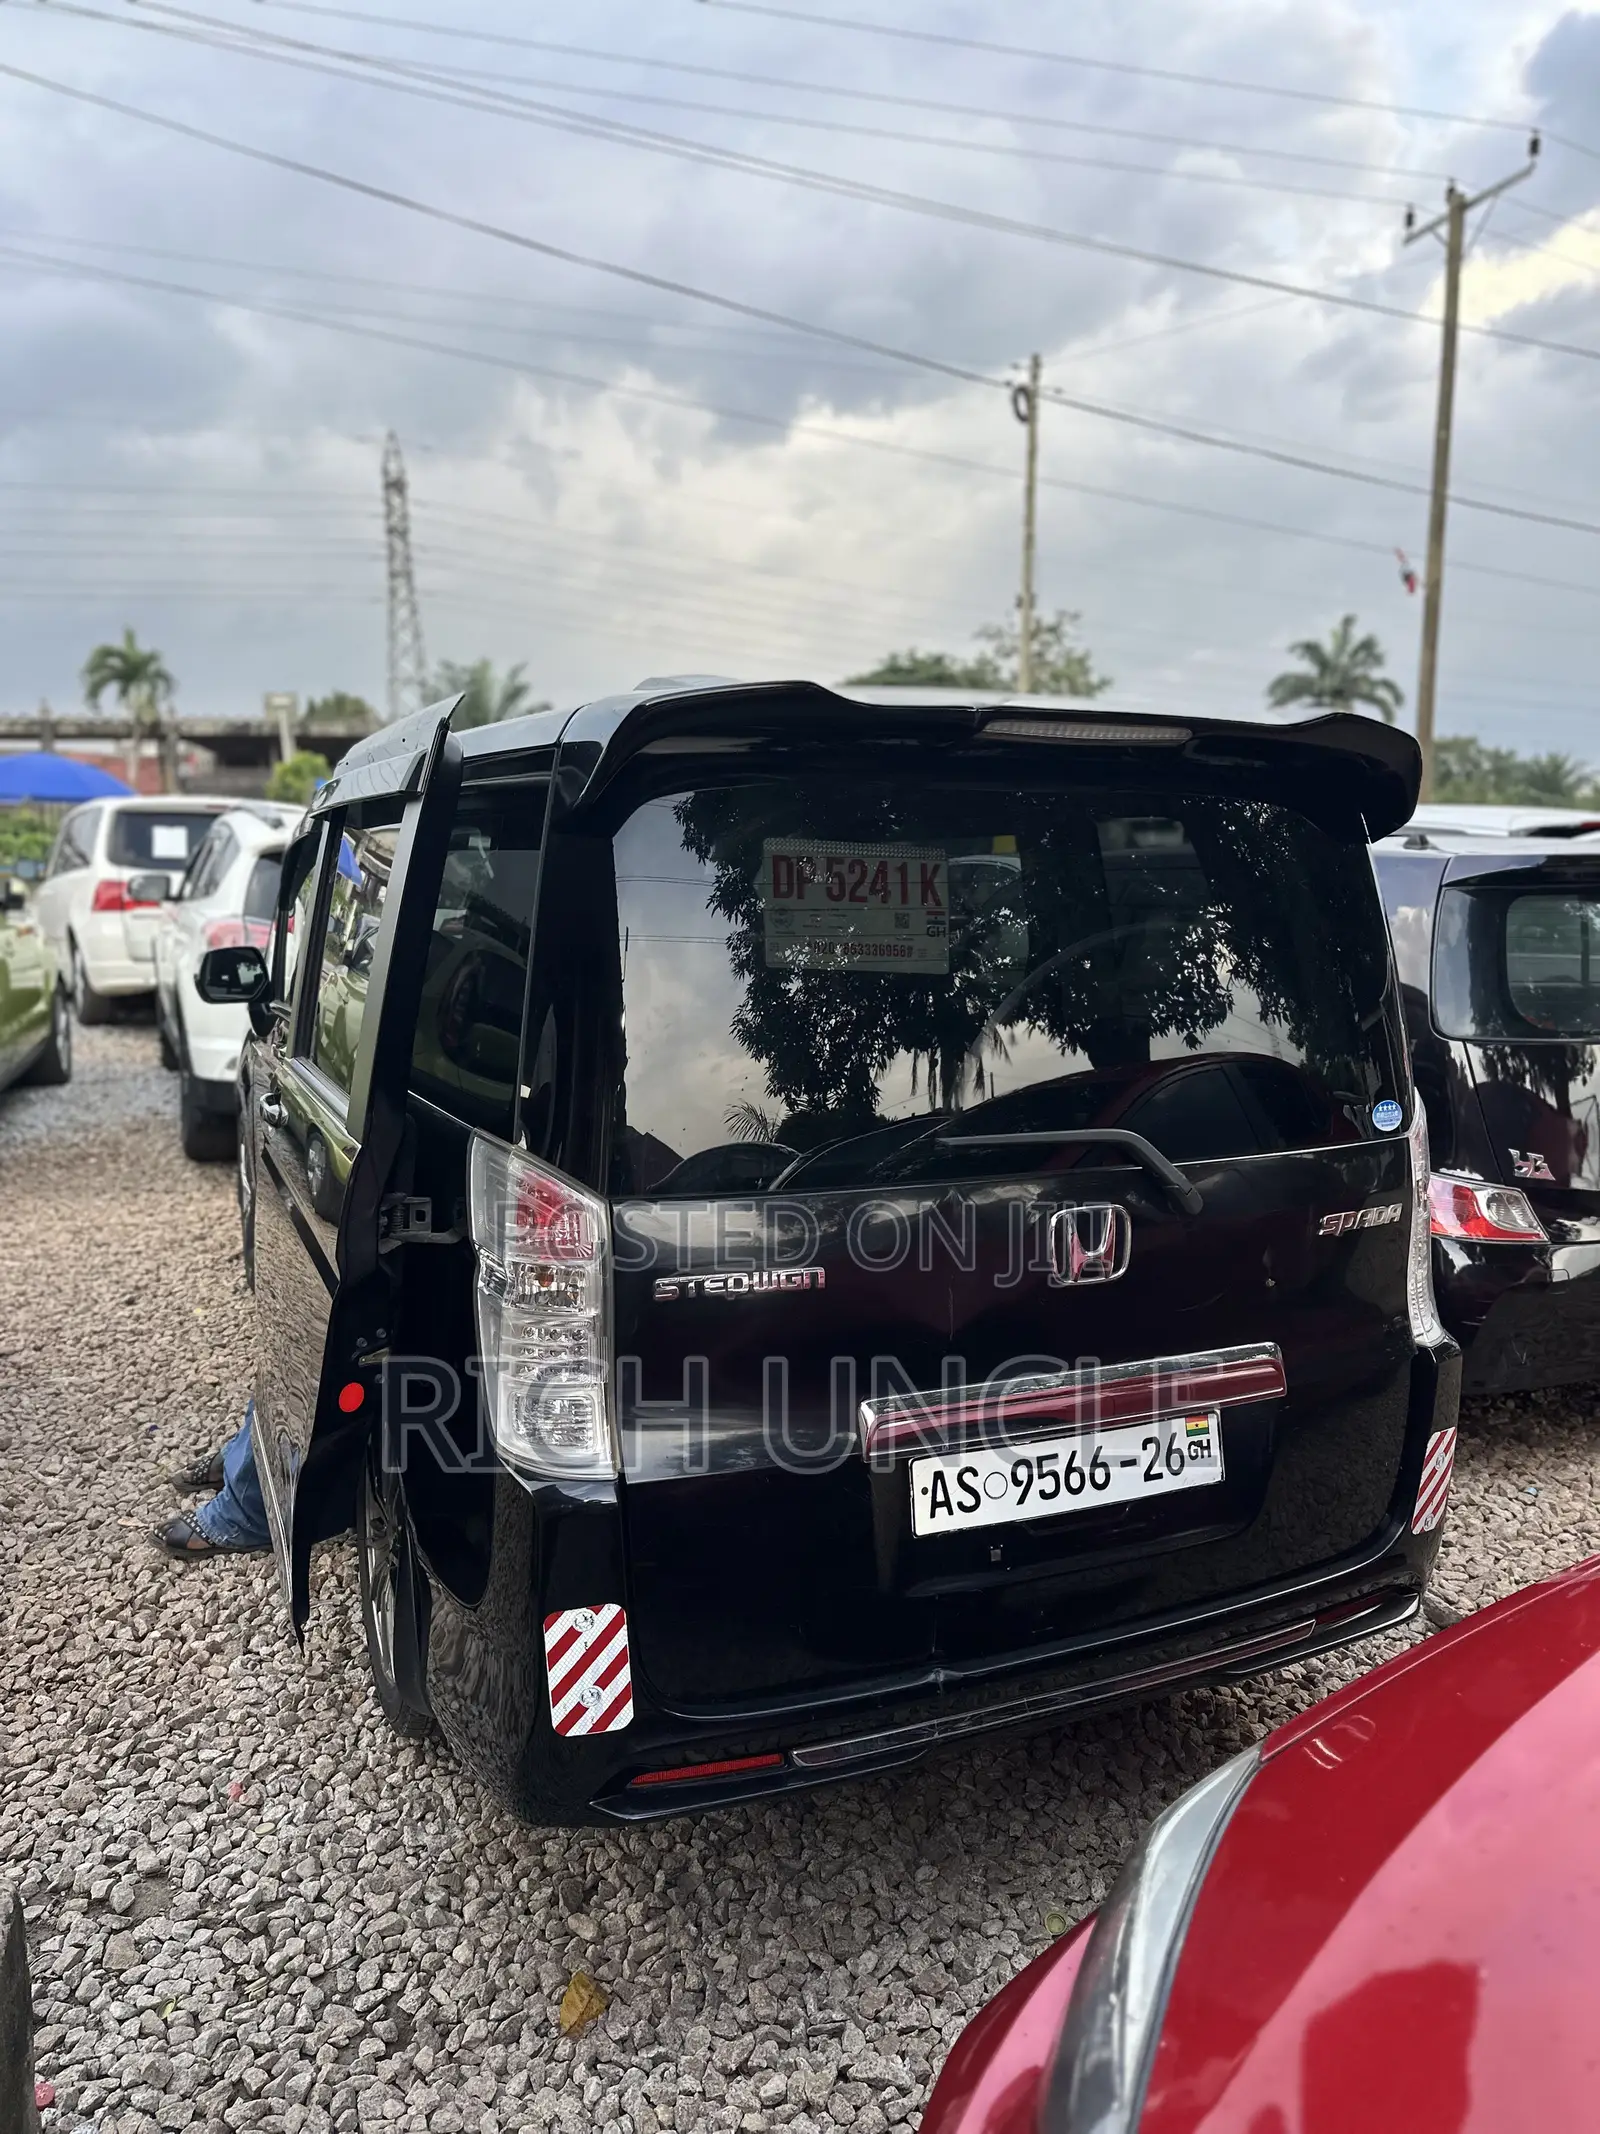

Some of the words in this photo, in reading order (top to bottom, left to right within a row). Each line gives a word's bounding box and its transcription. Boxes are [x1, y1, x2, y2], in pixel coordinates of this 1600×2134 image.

[772, 855, 817, 900] DP
[826, 858, 910, 906] 5241
[920, 862, 943, 907] K
[926, 926, 947, 938] GH
[1319, 1203, 1403, 1238] SPADA
[1187, 1438, 1212, 1462] GH
[929, 1465, 983, 1520] AS
